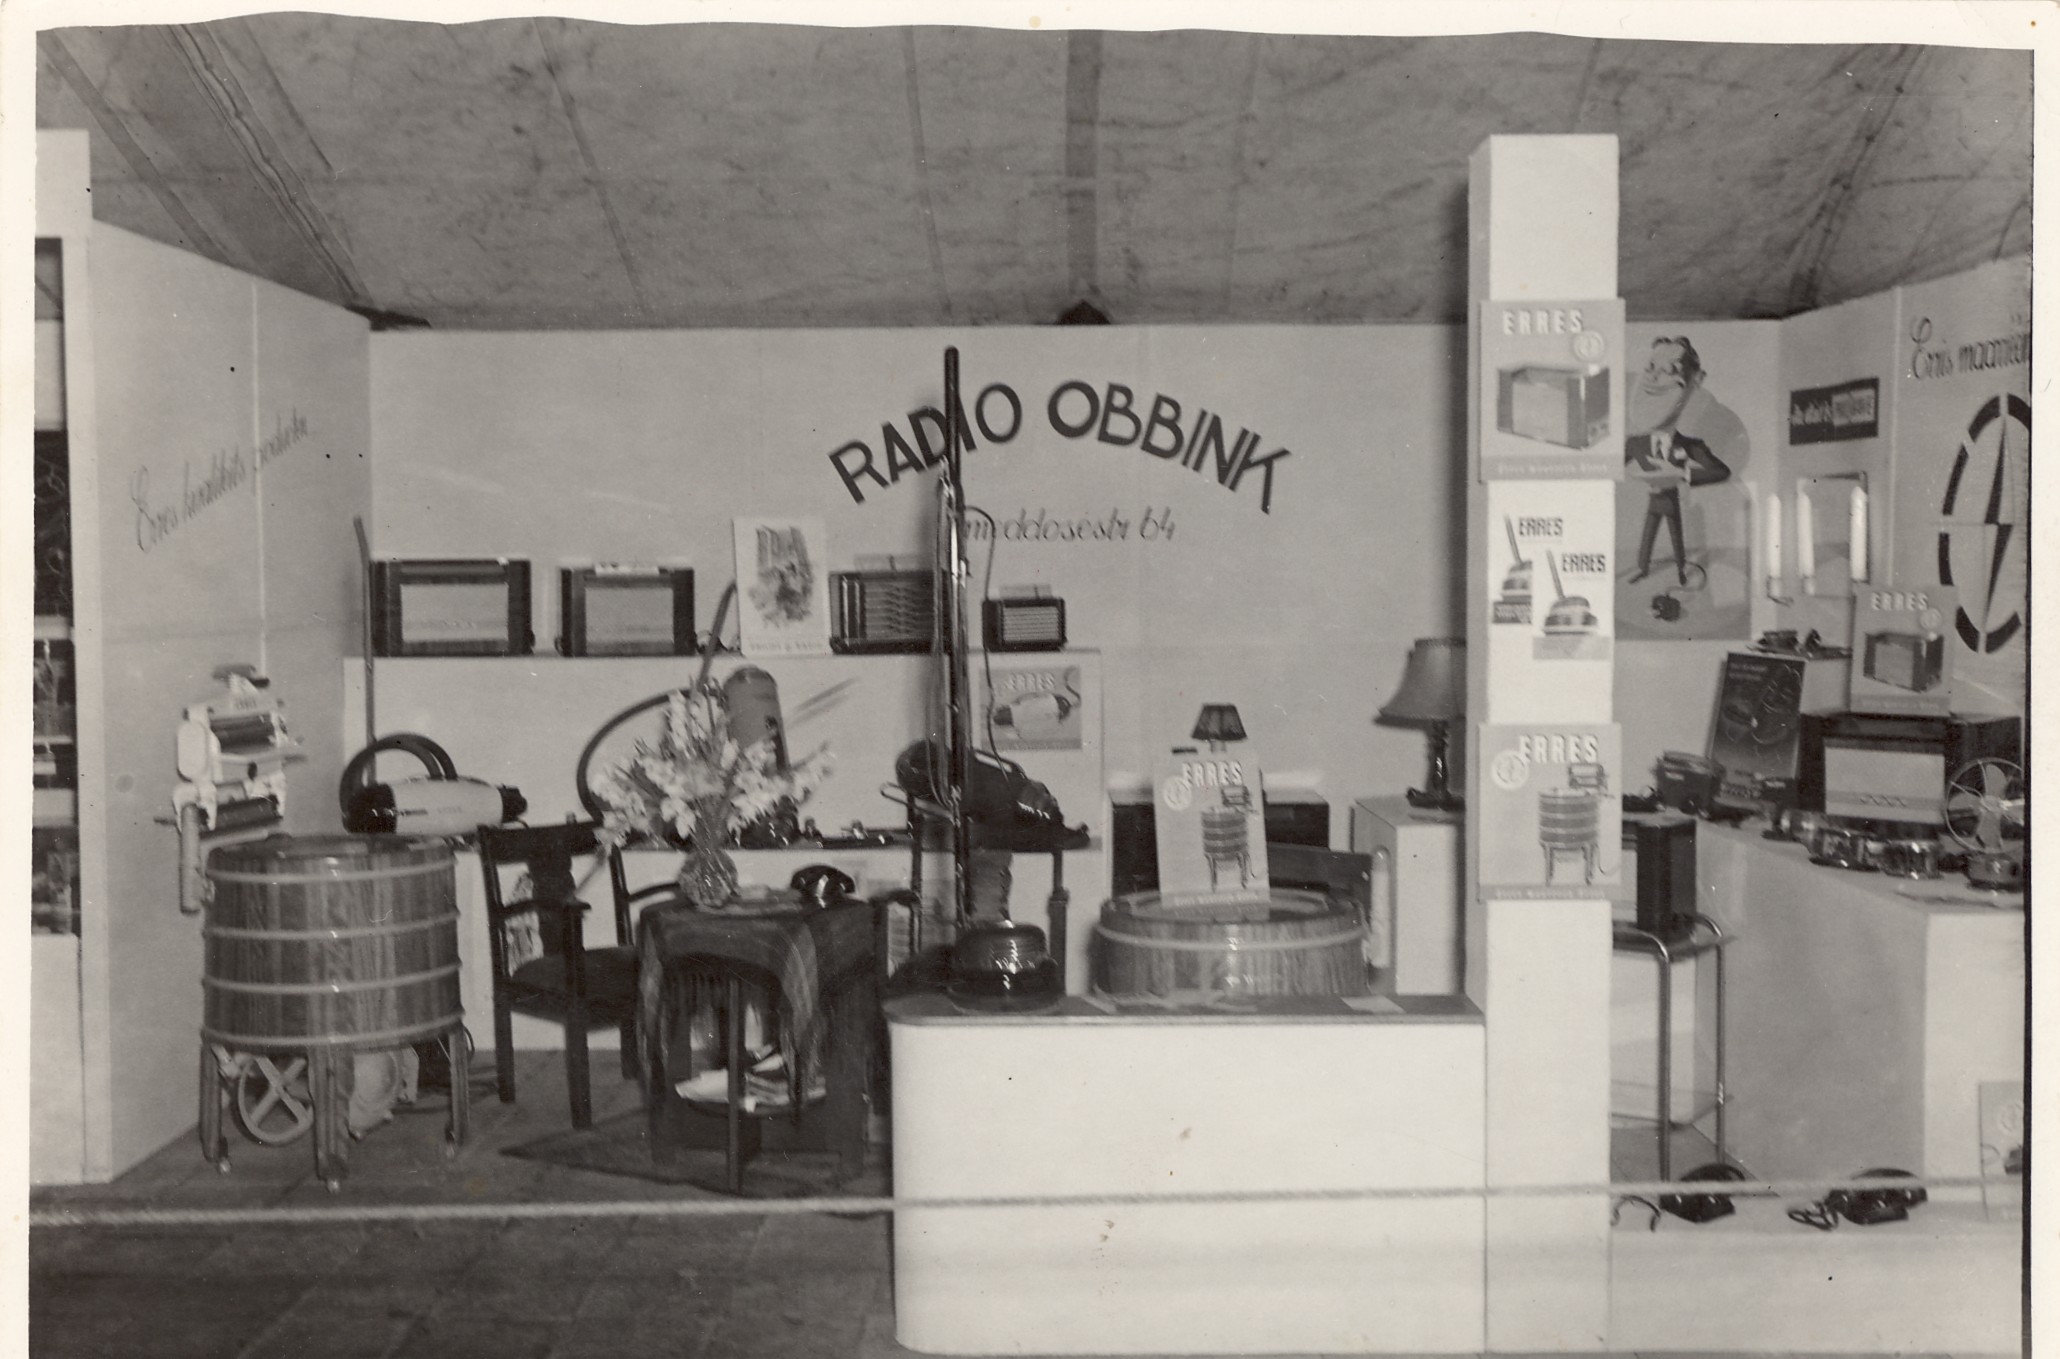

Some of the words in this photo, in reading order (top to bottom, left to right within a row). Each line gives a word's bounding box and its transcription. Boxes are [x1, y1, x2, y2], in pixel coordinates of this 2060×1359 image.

[1502, 308, 1584, 335] ERRES
[827, 382, 1023, 505] RADIO
[1047, 379, 1292, 516] OBBINK
[1139, 505, 1176, 541] 64
[1518, 516, 1564, 537] ERRES
[1561, 552, 1607, 573] ERRES
[1871, 591, 1930, 612] ERRES
[1518, 733, 1599, 764] ERRES
[1181, 760, 1243, 787] ERRES
